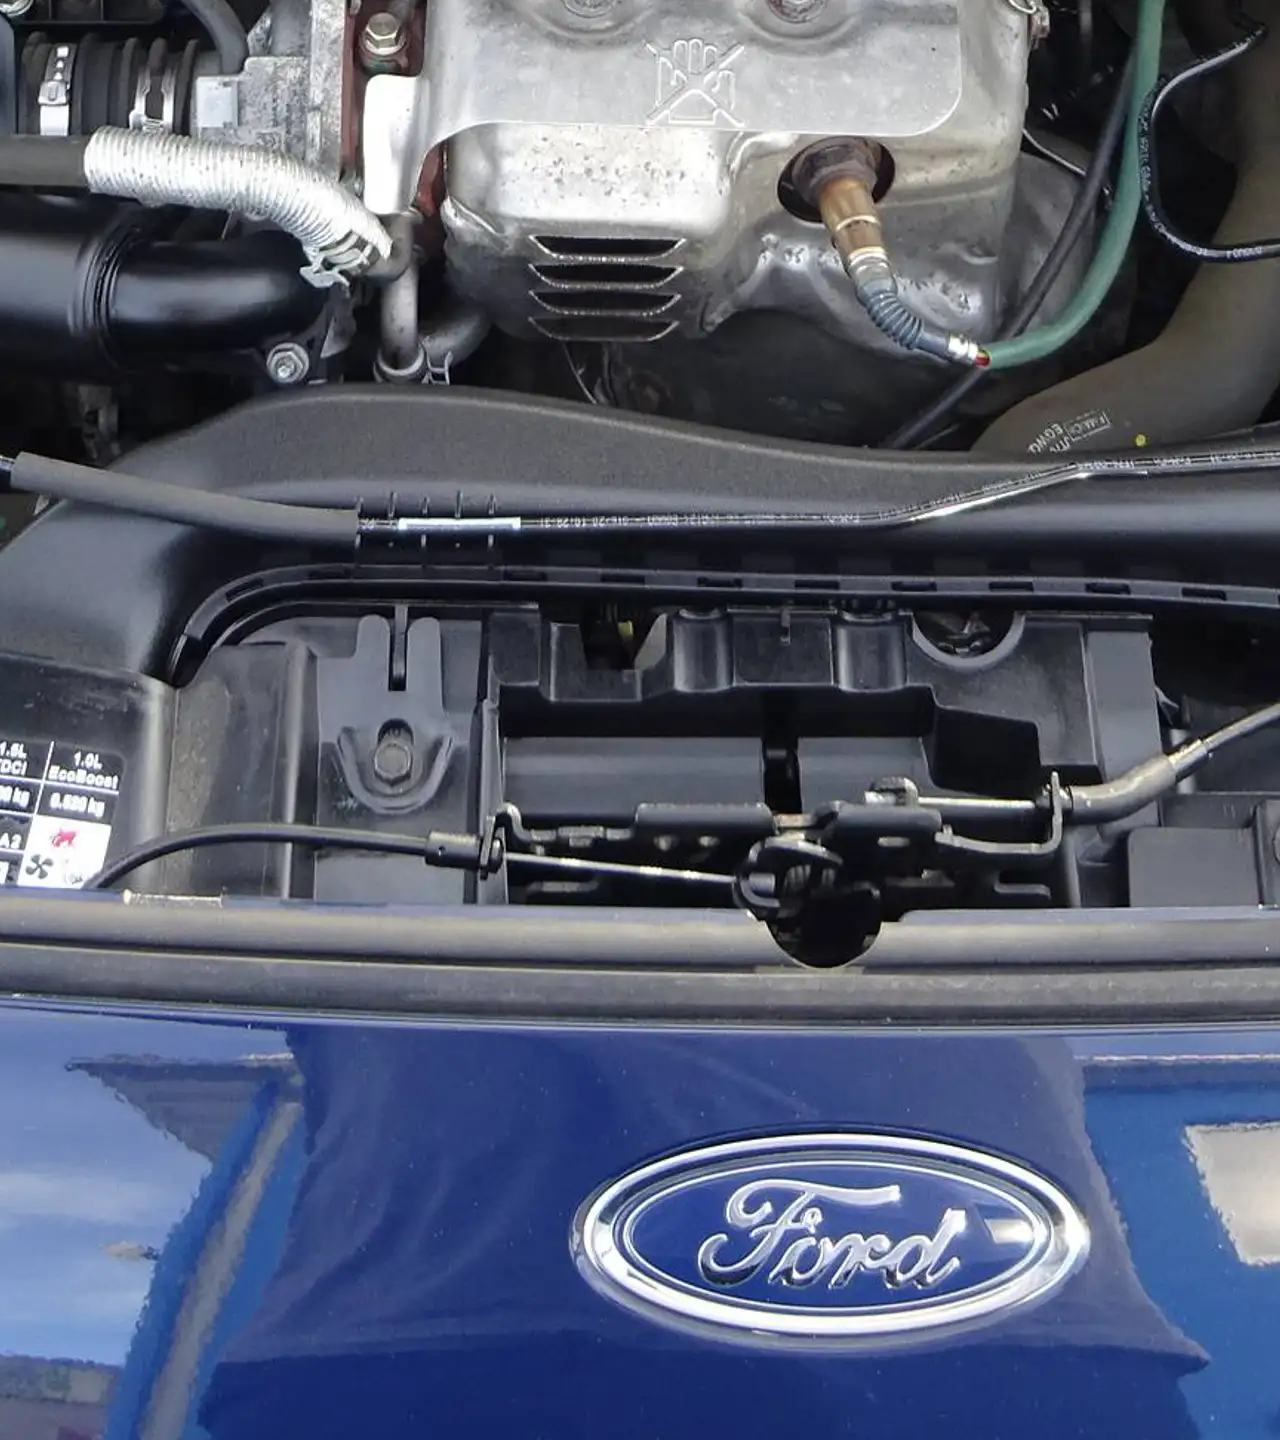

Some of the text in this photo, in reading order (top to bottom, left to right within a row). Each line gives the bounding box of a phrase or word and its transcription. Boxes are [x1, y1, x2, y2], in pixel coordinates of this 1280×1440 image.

[74, 751, 103, 770] 1.0L
[48, 765, 119, 790] EcoBoost
[697, 1179, 966, 1289] Ford
